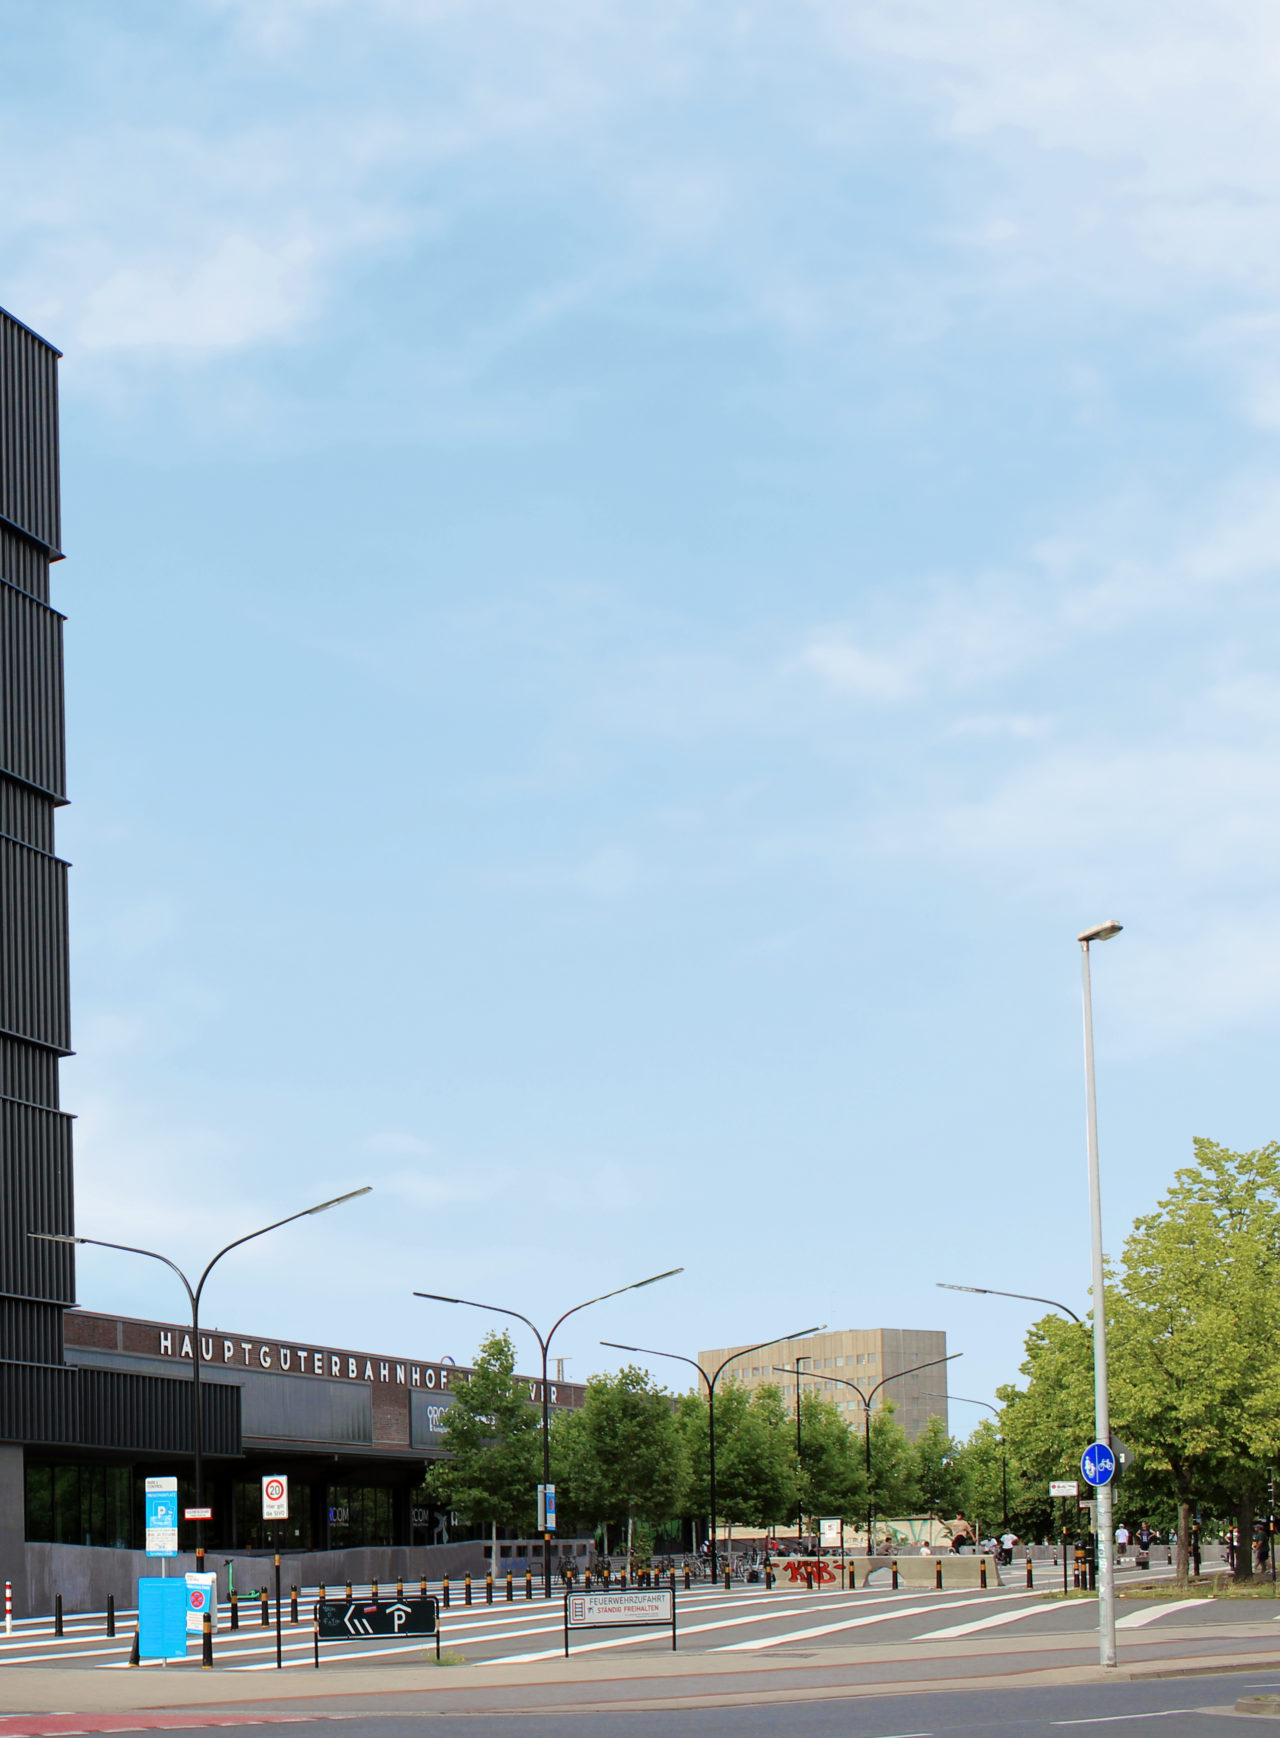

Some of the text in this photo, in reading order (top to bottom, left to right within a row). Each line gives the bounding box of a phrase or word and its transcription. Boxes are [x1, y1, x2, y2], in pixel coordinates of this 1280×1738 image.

[160, 1331, 448, 1389] HAUPTGÜTERBAHNHOF
[270, 1485, 280, 1496] 20
[157, 1505, 166, 1519] P
[589, 1594, 666, 1606] FEUERWEHRZUFAHRT
[624, 1604, 659, 1612] FREIHALTEN
[394, 1610, 406, 1632] P
